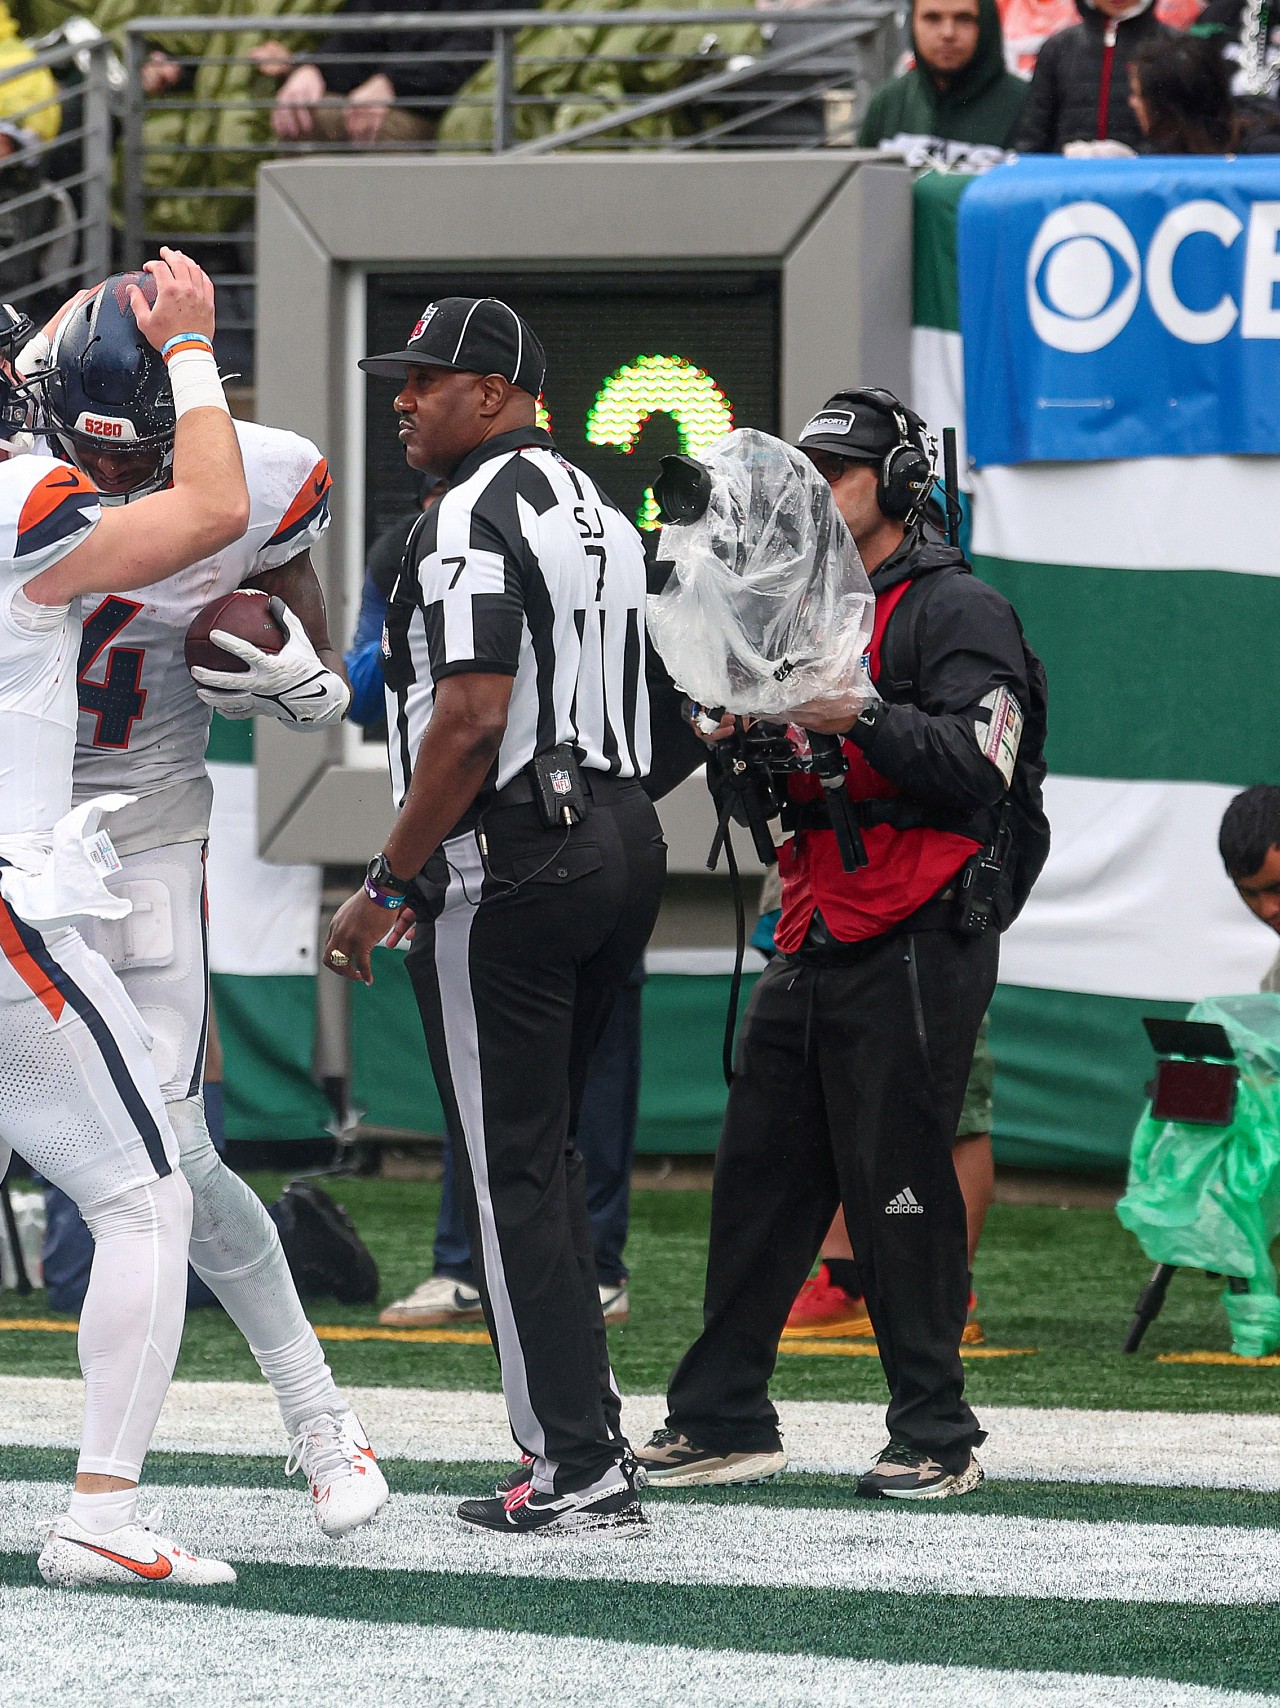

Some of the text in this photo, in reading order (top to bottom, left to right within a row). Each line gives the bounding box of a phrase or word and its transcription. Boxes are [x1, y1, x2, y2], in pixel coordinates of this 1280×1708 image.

[85, 418, 123, 437] 5280
[573, 506, 604, 539] SJ
[441, 556, 467, 591] 7
[584, 545, 607, 602] 7
[885, 1203, 924, 1215] adidas
